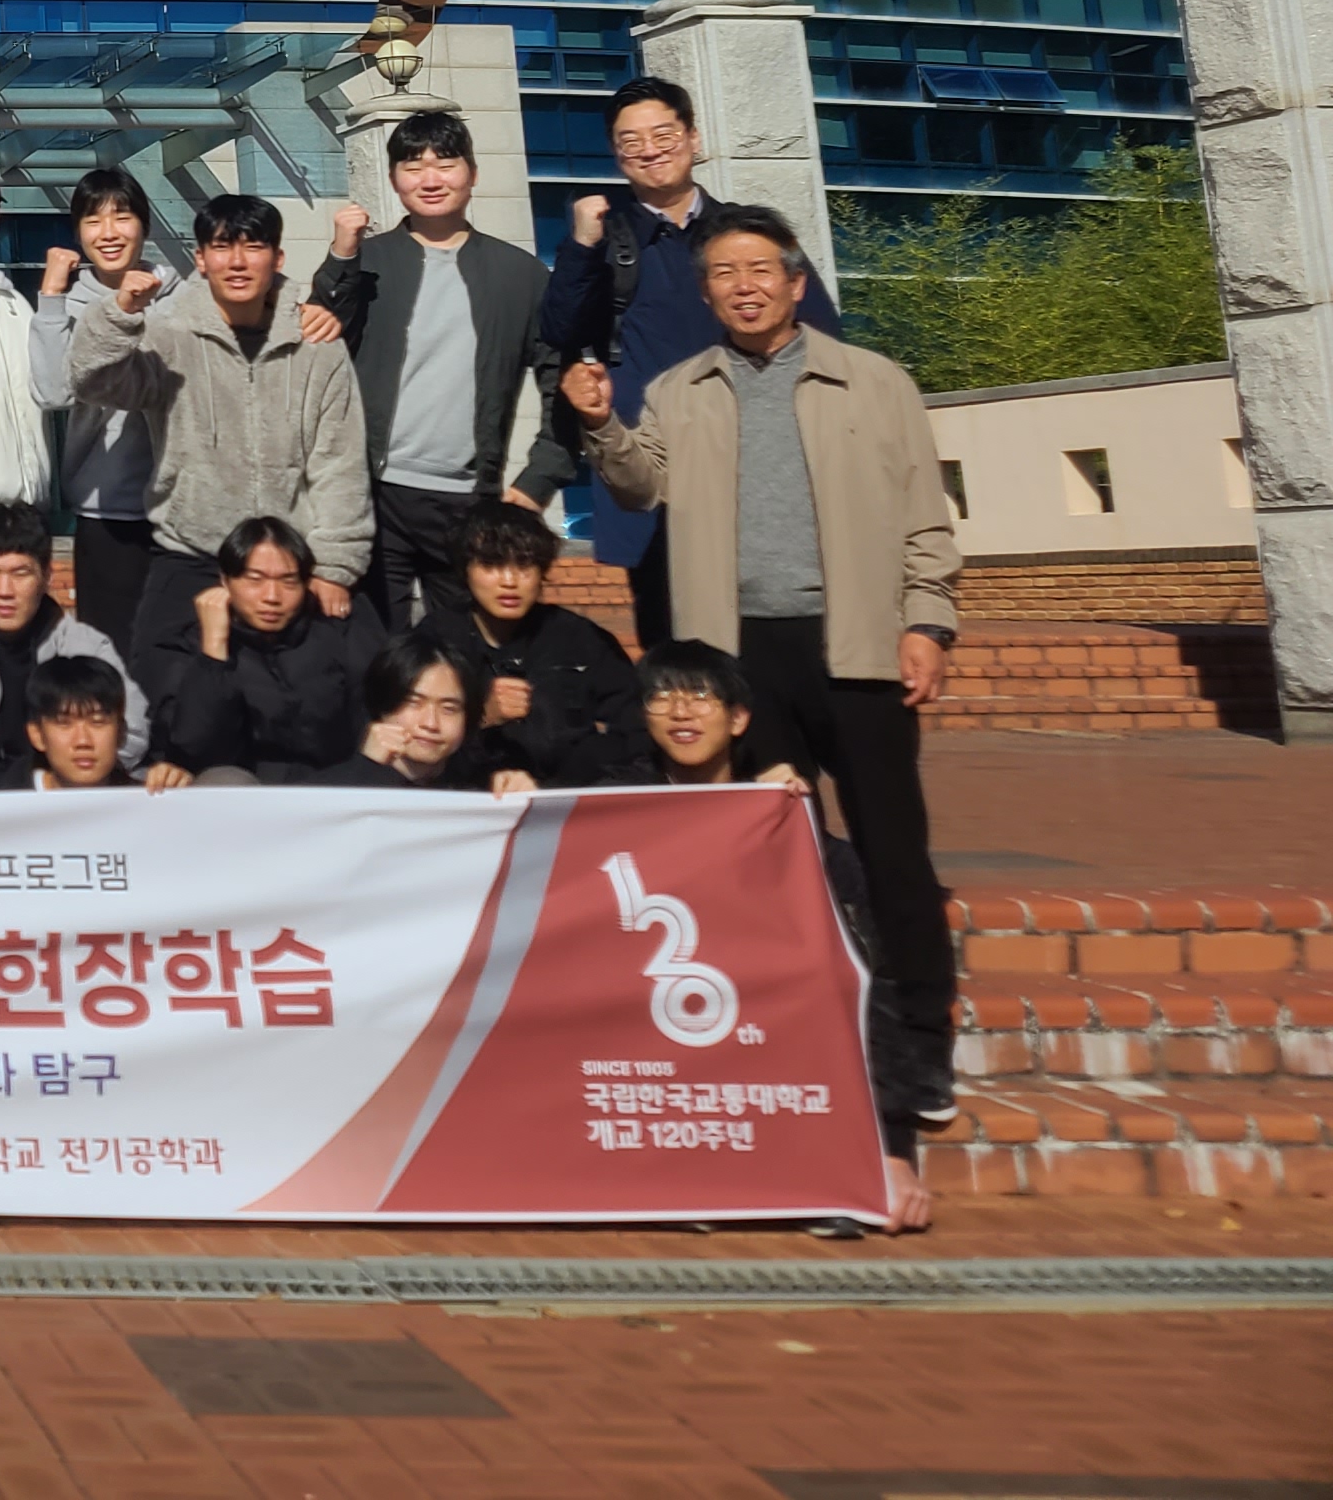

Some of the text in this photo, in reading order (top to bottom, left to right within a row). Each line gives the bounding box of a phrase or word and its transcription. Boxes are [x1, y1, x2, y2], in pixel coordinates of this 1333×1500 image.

[32, 1052, 122, 1097] 탐구
[581, 1061, 632, 1077] SINCE
[583, 1083, 832, 1116] 국립한국교통대학교
[585, 1119, 756, 1152] 개교 120주년
[57, 1136, 227, 1176] 전기공학과
